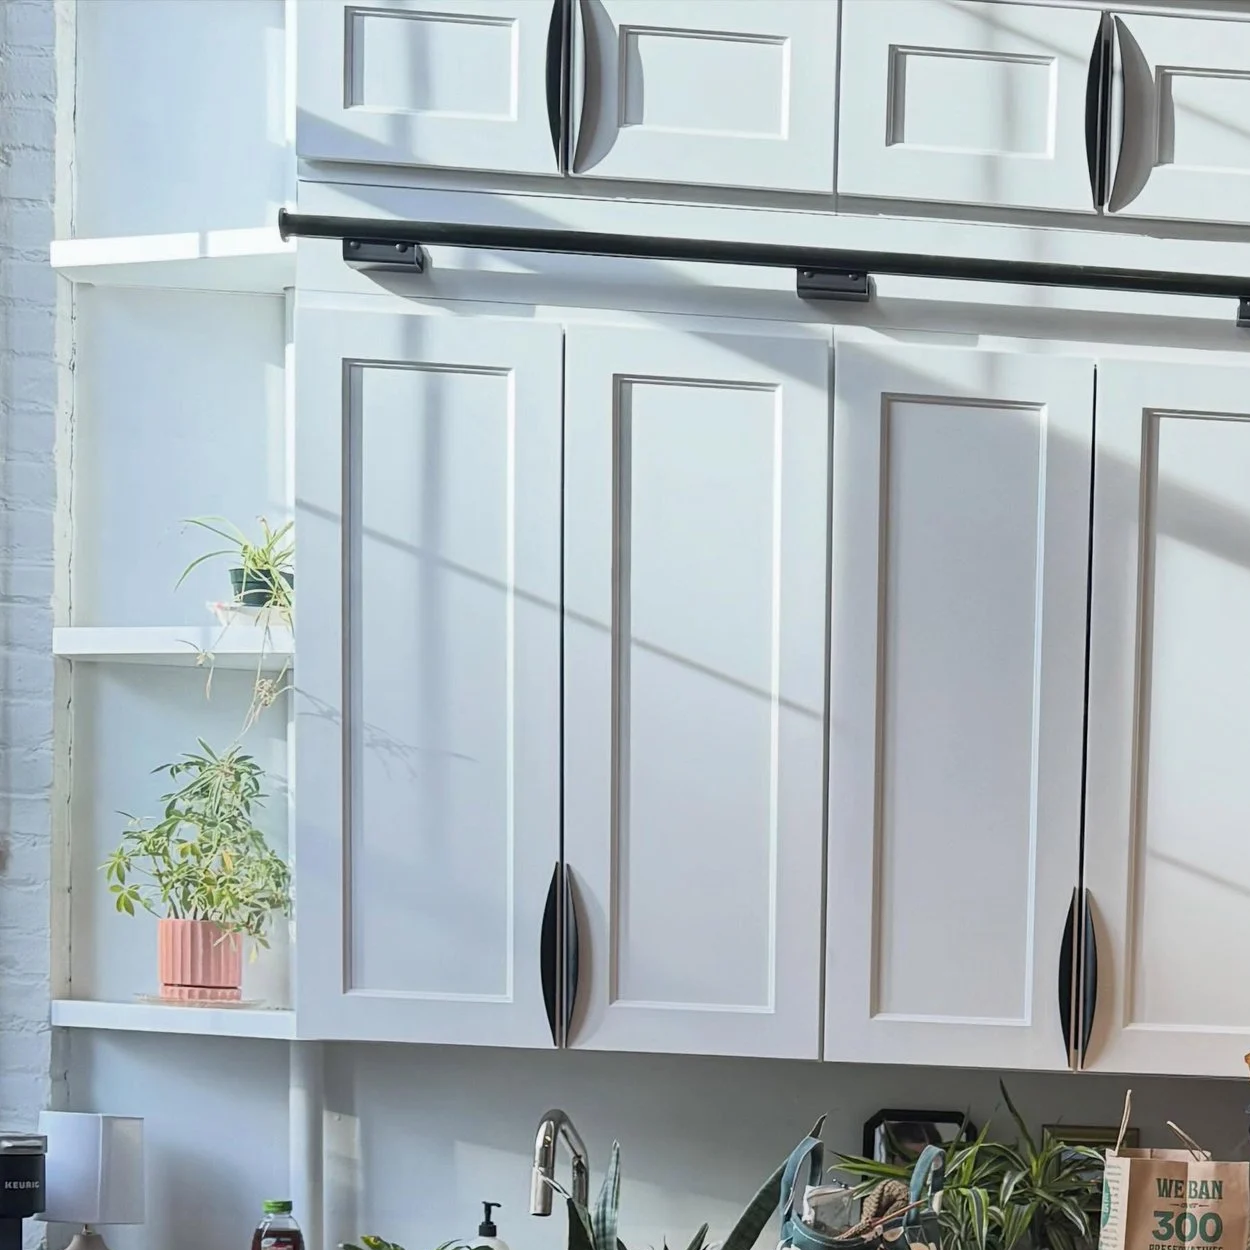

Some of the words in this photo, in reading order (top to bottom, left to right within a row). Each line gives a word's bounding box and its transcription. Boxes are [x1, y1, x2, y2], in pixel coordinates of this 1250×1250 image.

[4, 1180, 41, 1190] KEURIG
[1155, 1177, 1185, 1198] WE
[1187, 1180, 1224, 1200] BAN
[1152, 1211, 1223, 1243] 300
